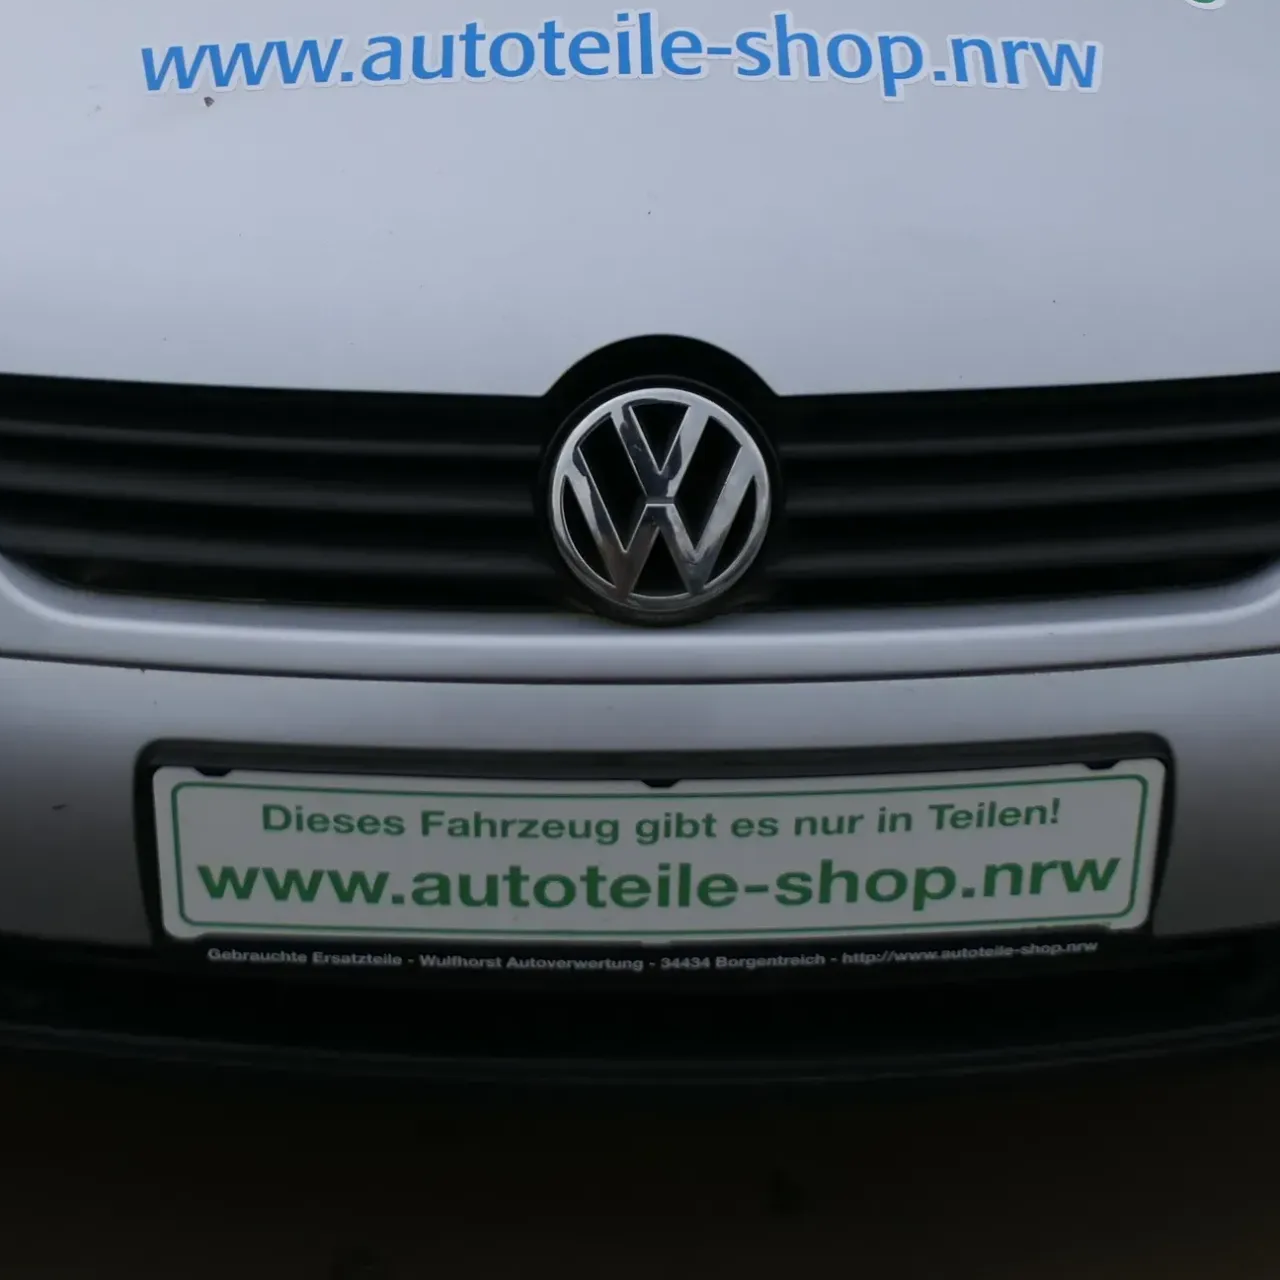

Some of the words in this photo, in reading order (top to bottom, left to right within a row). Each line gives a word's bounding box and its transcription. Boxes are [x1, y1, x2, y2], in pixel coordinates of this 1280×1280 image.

[141, 11, 1098, 98] www.autoteile-shop.nrw
[552, 388, 770, 612] VW
[261, 803, 405, 836] Dieses
[420, 808, 621, 846] Fahrzeug
[634, 807, 718, 844] gibt
[730, 811, 779, 839] es
[794, 810, 864, 837] nur
[877, 805, 914, 835] in
[927, 797, 1061, 832] Teilen!
[196, 857, 1121, 911] www.autoteile-shop.nrw
[207, 947, 308, 963] Gebrauchte
[312, 951, 403, 965] Ersatzteile
[420, 955, 502, 967] Wulfhorst
[506, 956, 644, 971] Autoverwertung
[660, 956, 710, 969] 34434
[715, 953, 826, 970] Borgentreich
